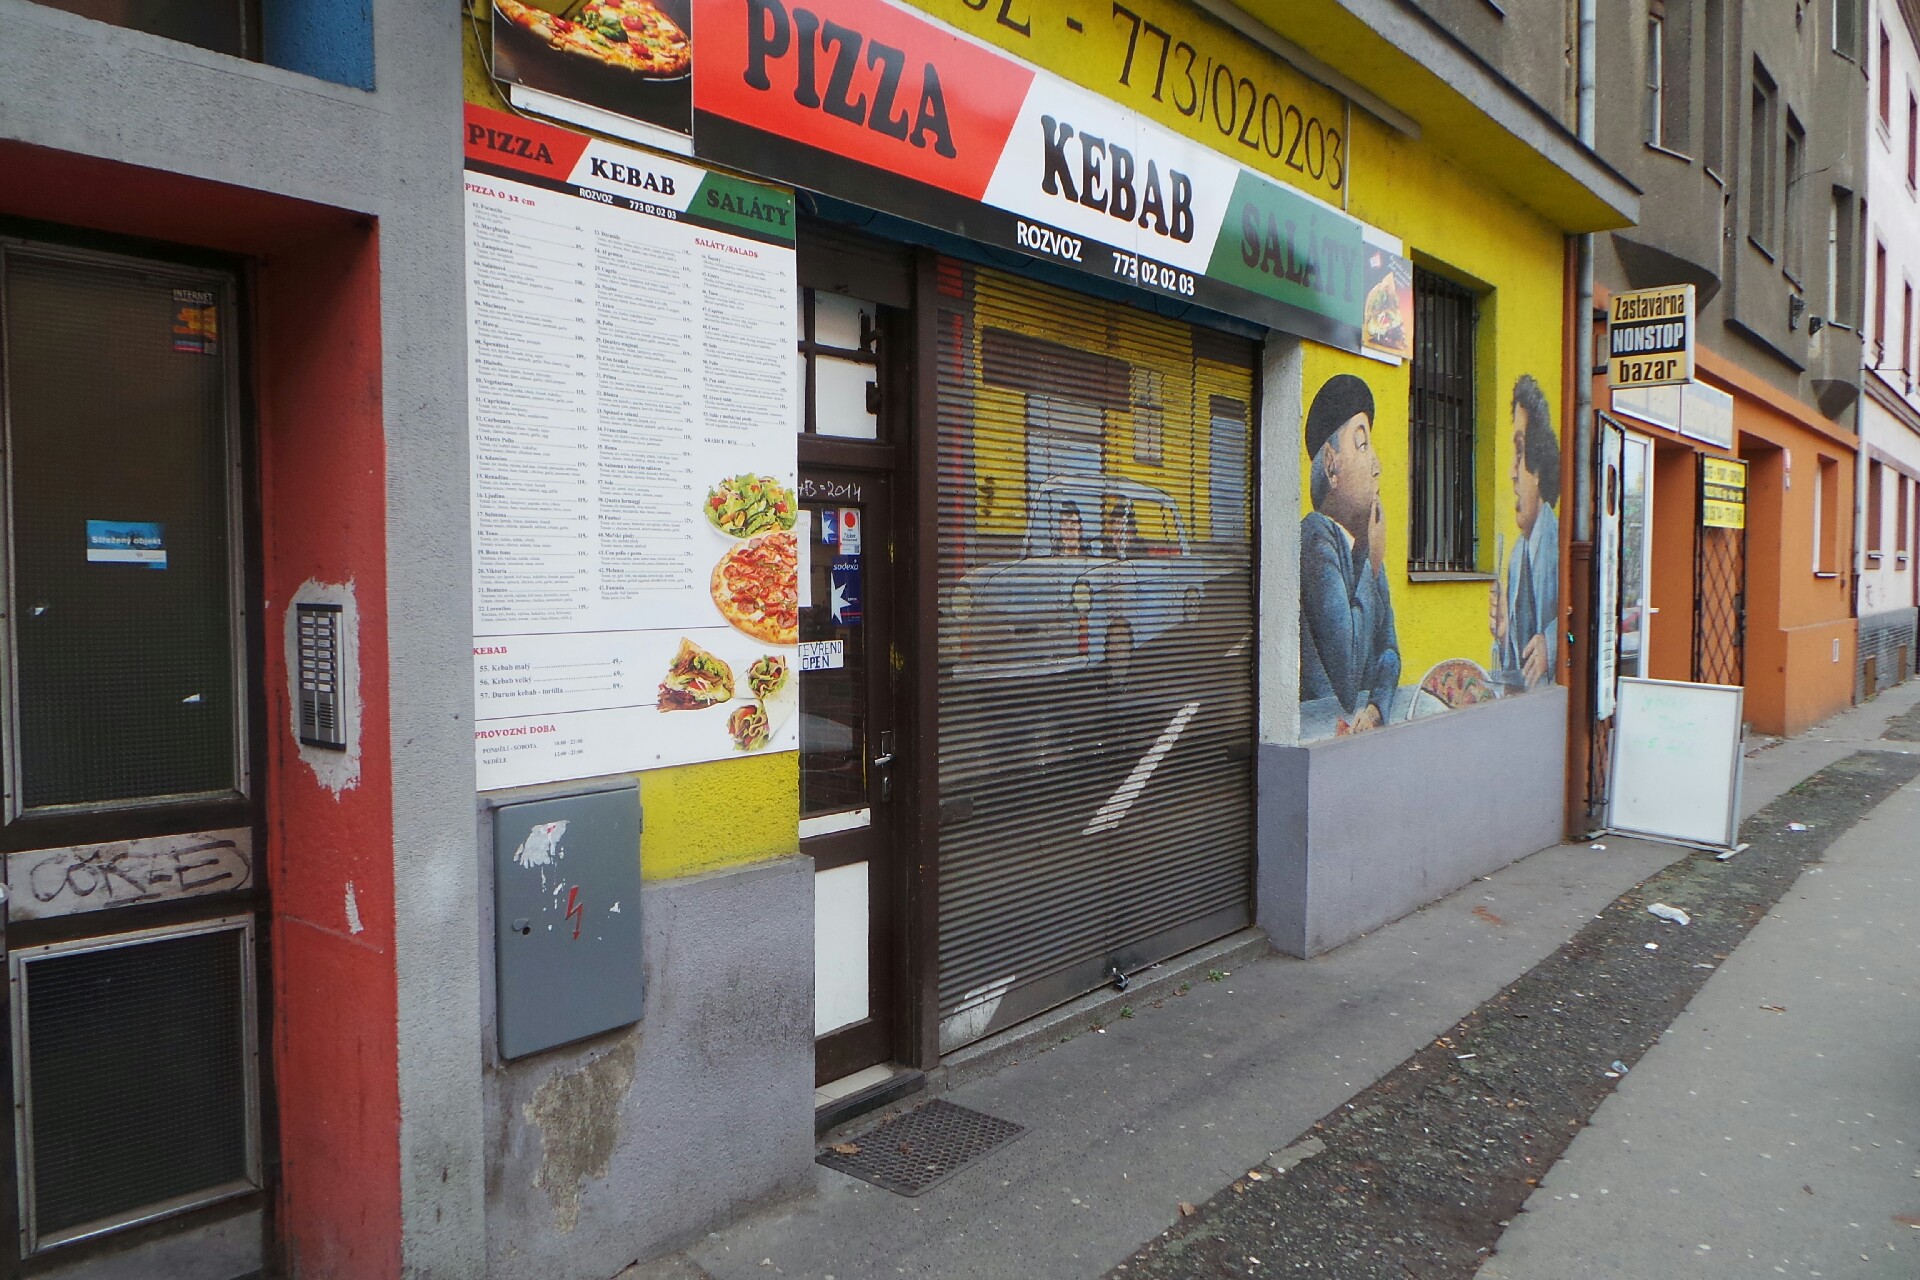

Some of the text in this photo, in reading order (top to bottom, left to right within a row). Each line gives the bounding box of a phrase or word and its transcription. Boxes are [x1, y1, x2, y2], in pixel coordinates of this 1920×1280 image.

[743, 0, 957, 159] PIZZA
[1113, 2, 1343, 190] 773/020203
[468, 123, 553, 165] PIZZA
[590, 157, 676, 197] KEBAB
[1041, 114, 1194, 244] KEBAB
[464, 182, 496, 198] PIZZA
[508, 194, 520, 203] 32
[521, 198, 536, 207] cm
[579, 187, 677, 220] ROZVOZ 773 02 02 03
[706, 188, 790, 226] SALÁTY
[695, 237, 759, 259] SALÁTY/SALADS
[1017, 221, 1195, 296] ROZVOZ 773 02 02 03
[1241, 202, 1356, 303] SALÁTY
[1615, 293, 1684, 321] Zastavárna
[1613, 323, 1684, 353] NONSTOP
[1620, 359, 1677, 383] bazar
[833, 561, 859, 571] sodexo
[473, 646, 508, 655] KEBAB
[802, 655, 830, 669] OPEN
[491, 663, 514, 671] Kebab
[514, 662, 531, 671] malý
[492, 677, 514, 685] Kebab
[492, 690, 516, 698] Durum
[517, 689, 537, 697] kebab
[542, 687, 564, 695] tortilla
[474, 724, 556, 739] PROVOZNÍ DOBA
